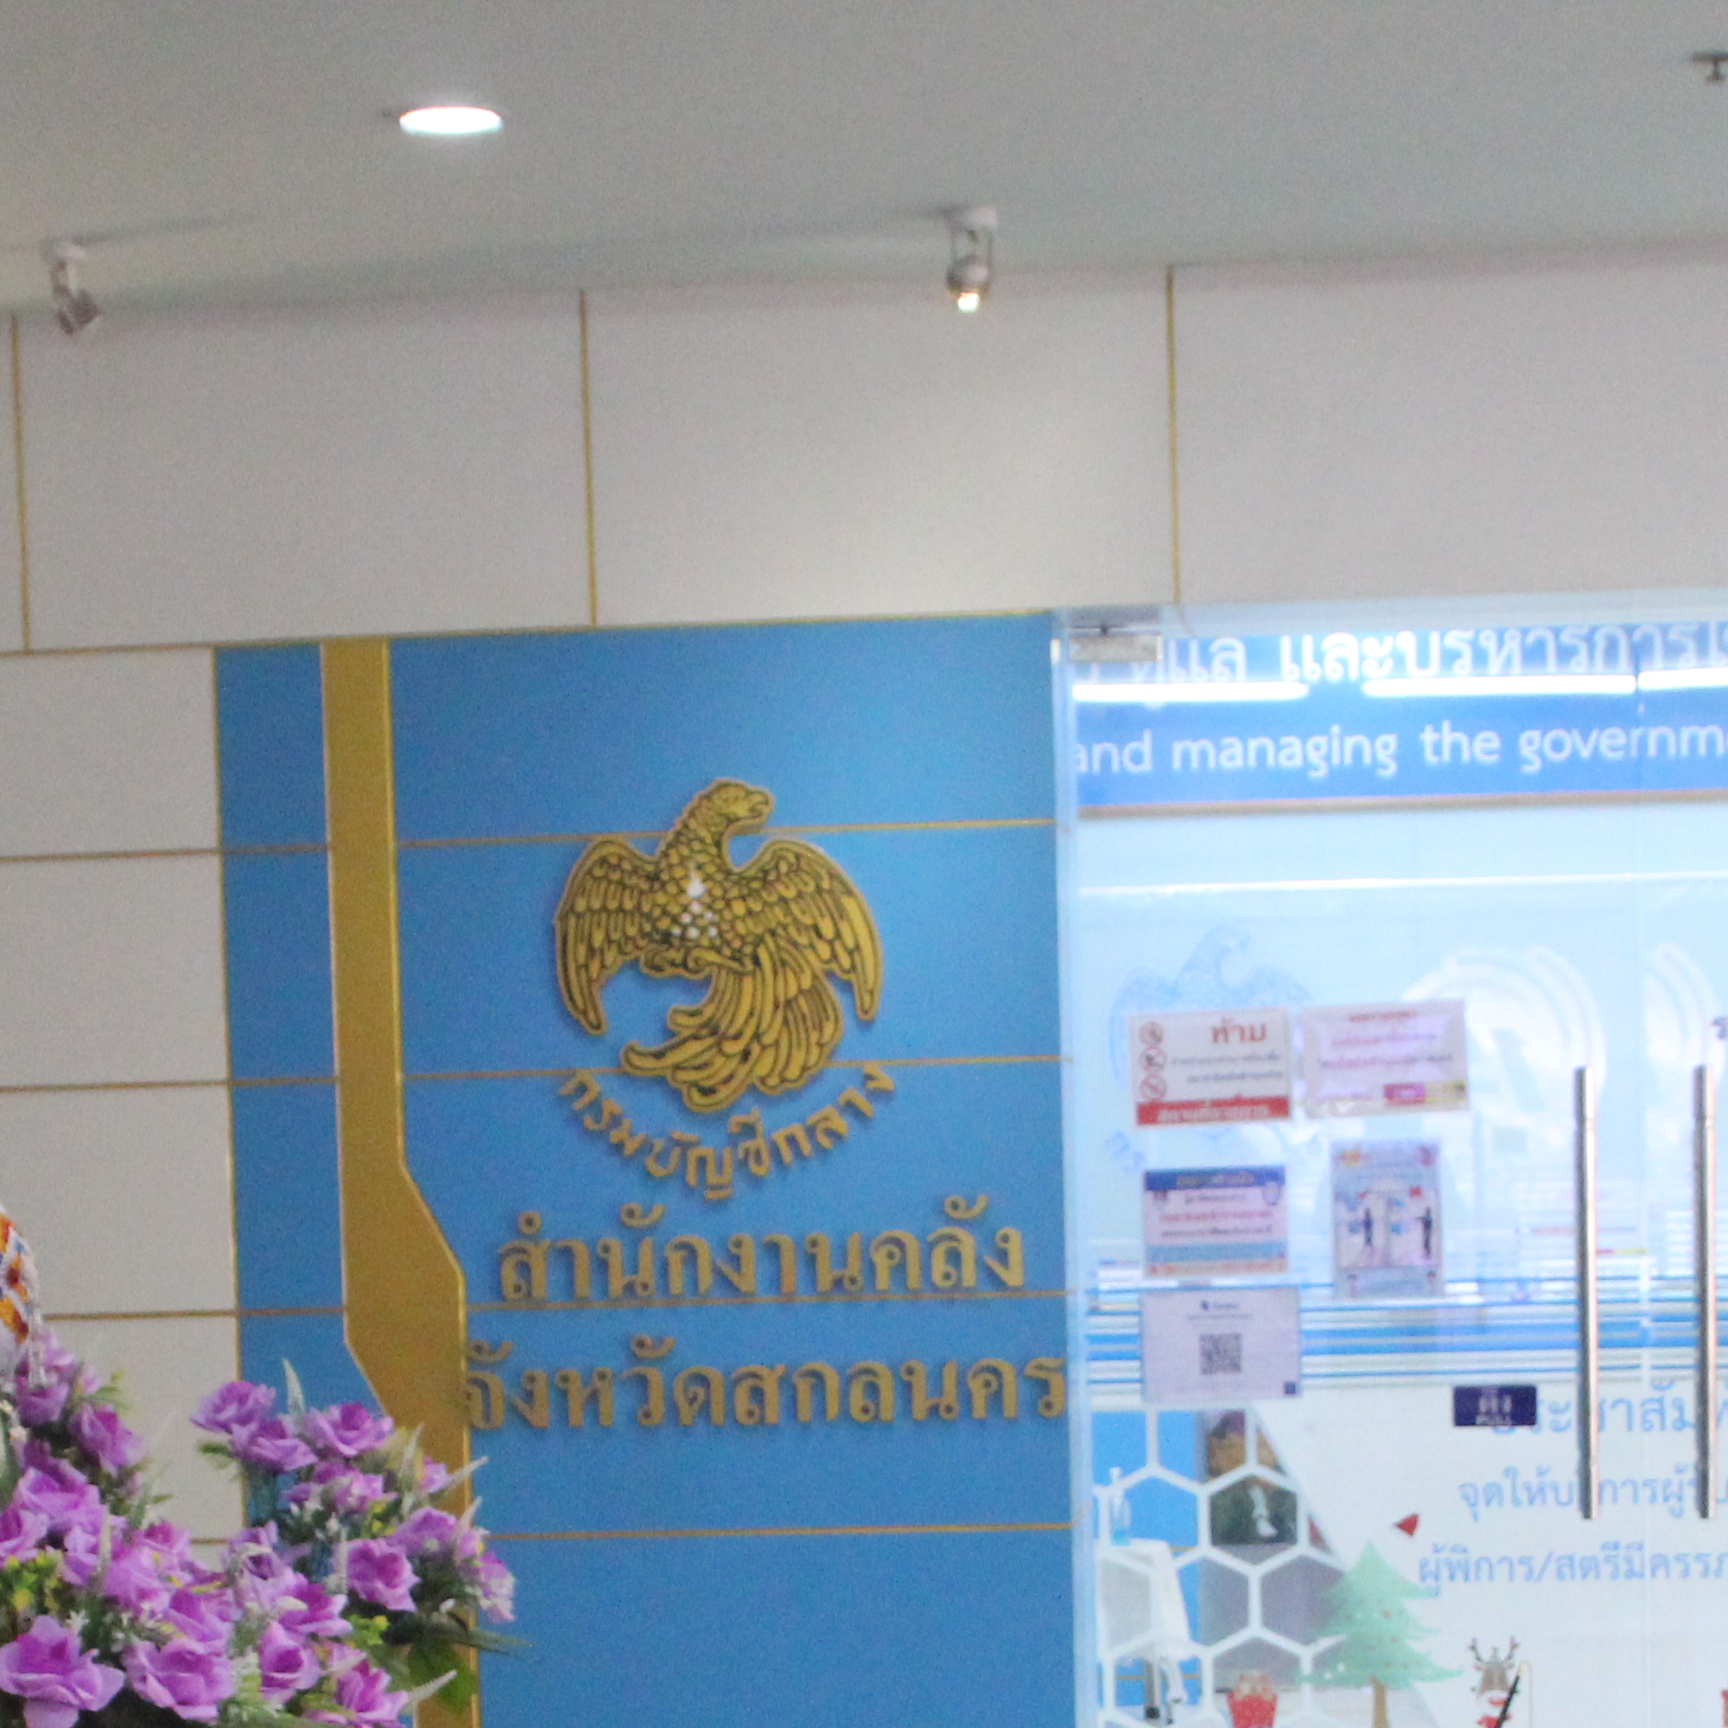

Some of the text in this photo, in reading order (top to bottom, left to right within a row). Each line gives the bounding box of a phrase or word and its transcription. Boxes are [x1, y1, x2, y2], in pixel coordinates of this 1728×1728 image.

[1076, 727, 1154, 775] and
[1172, 724, 1398, 779] managing
[1419, 720, 1502, 764] the
[559, 1063, 895, 1201] กรมบัญชีกลาง
[497, 1195, 1025, 1302] สำนักงานคลัง
[467, 1333, 1068, 1432] จังหวัดสกลนคร
